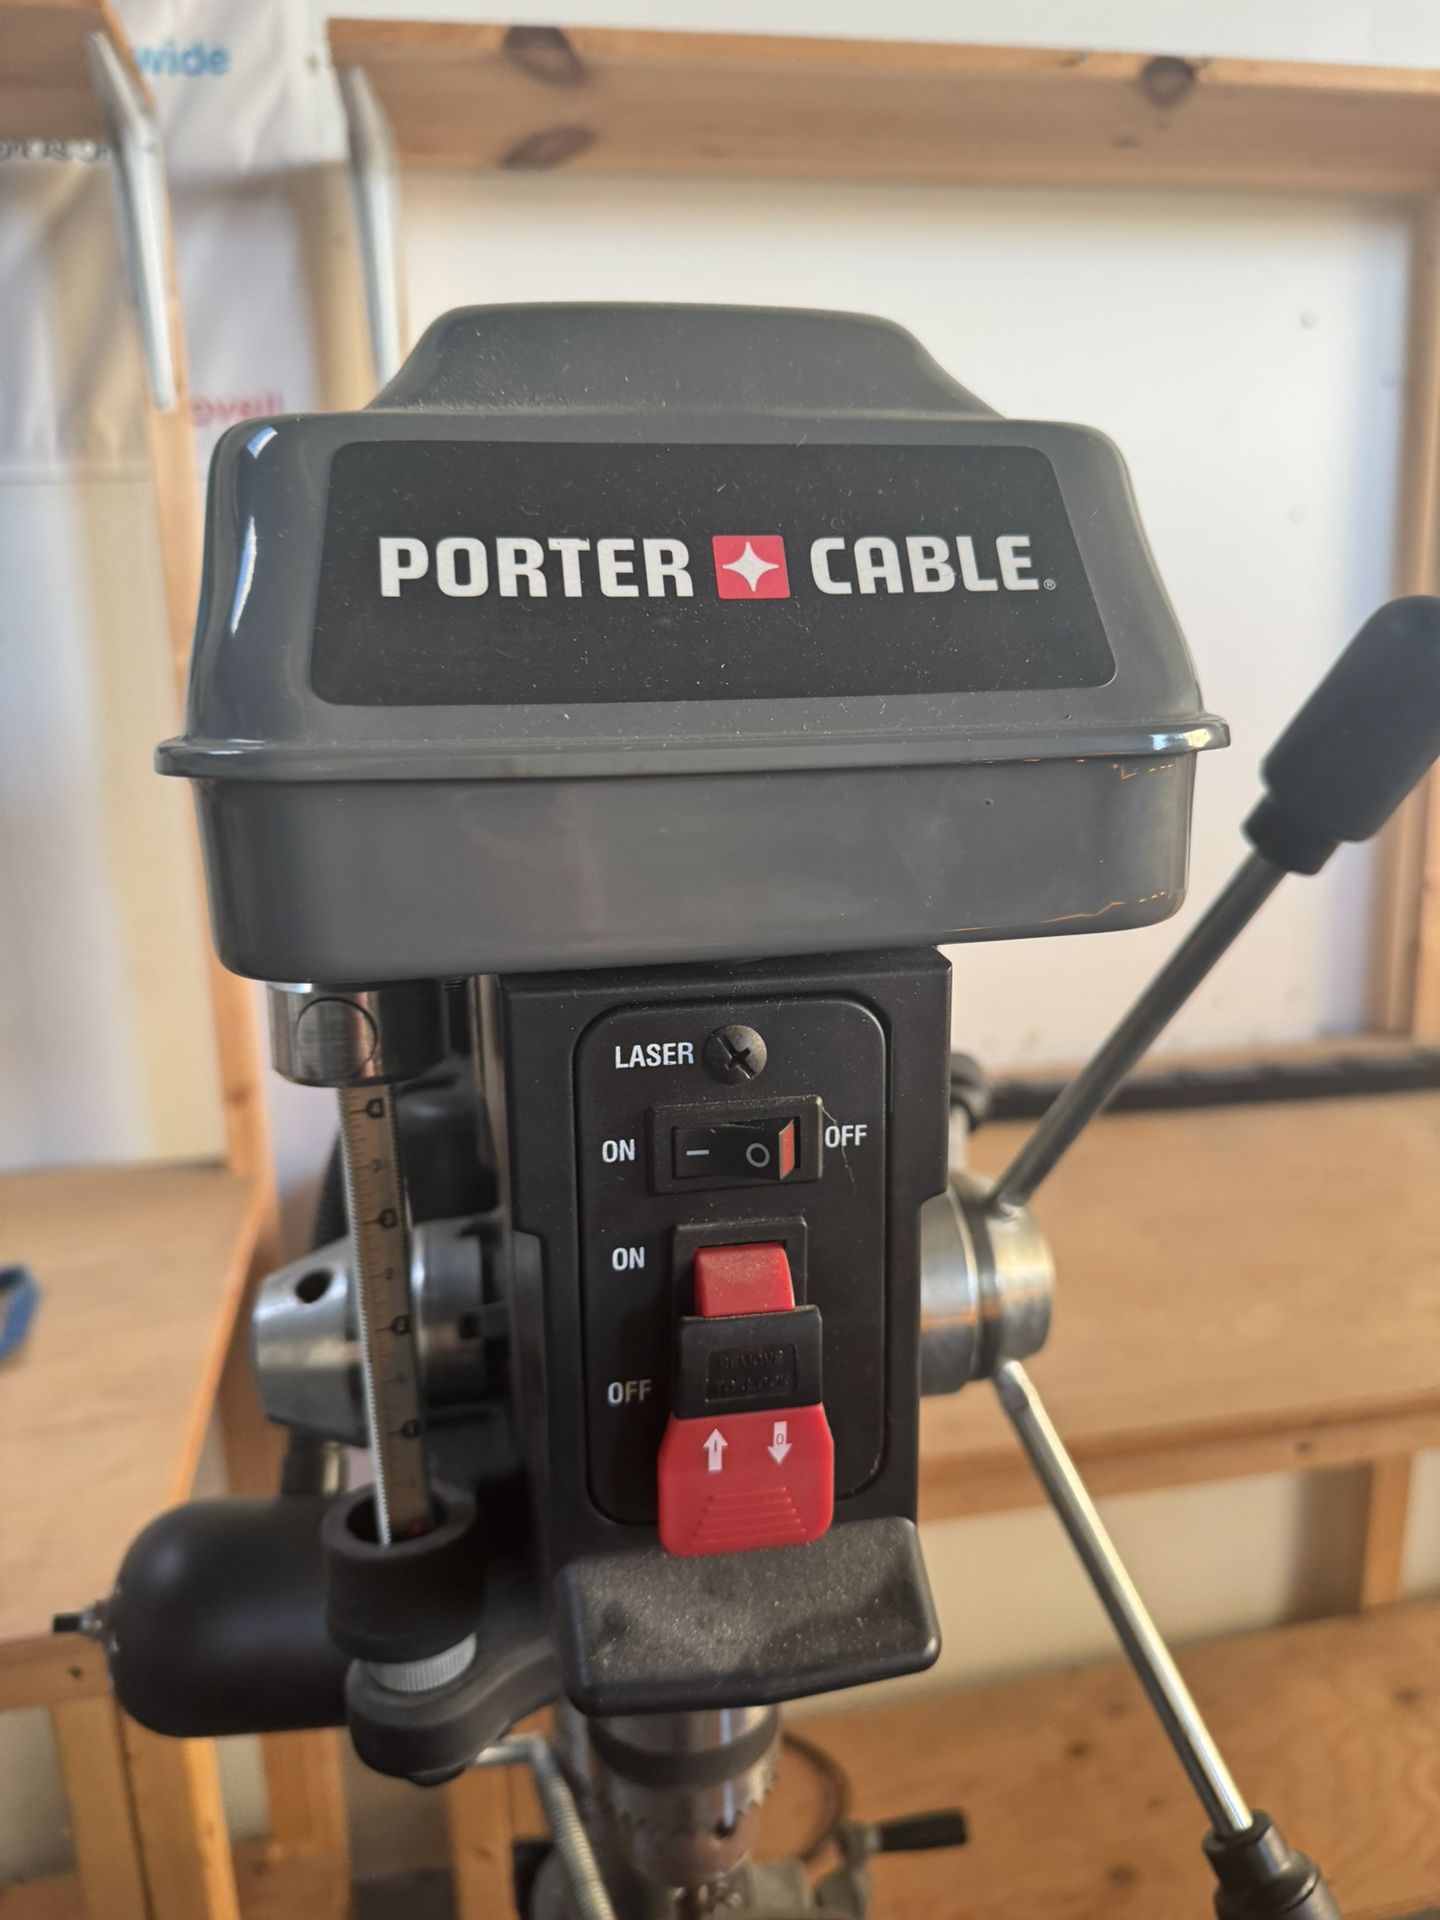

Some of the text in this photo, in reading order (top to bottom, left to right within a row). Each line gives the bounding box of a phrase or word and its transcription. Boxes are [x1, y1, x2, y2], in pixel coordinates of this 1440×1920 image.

[380, 536, 1039, 597] PORTER CABLE
[616, 1042, 693, 1068] LASER
[825, 1125, 867, 1147] OFF
[602, 1139, 635, 1162] ON
[612, 1247, 644, 1270] ON
[608, 1379, 651, 1404] OFF
